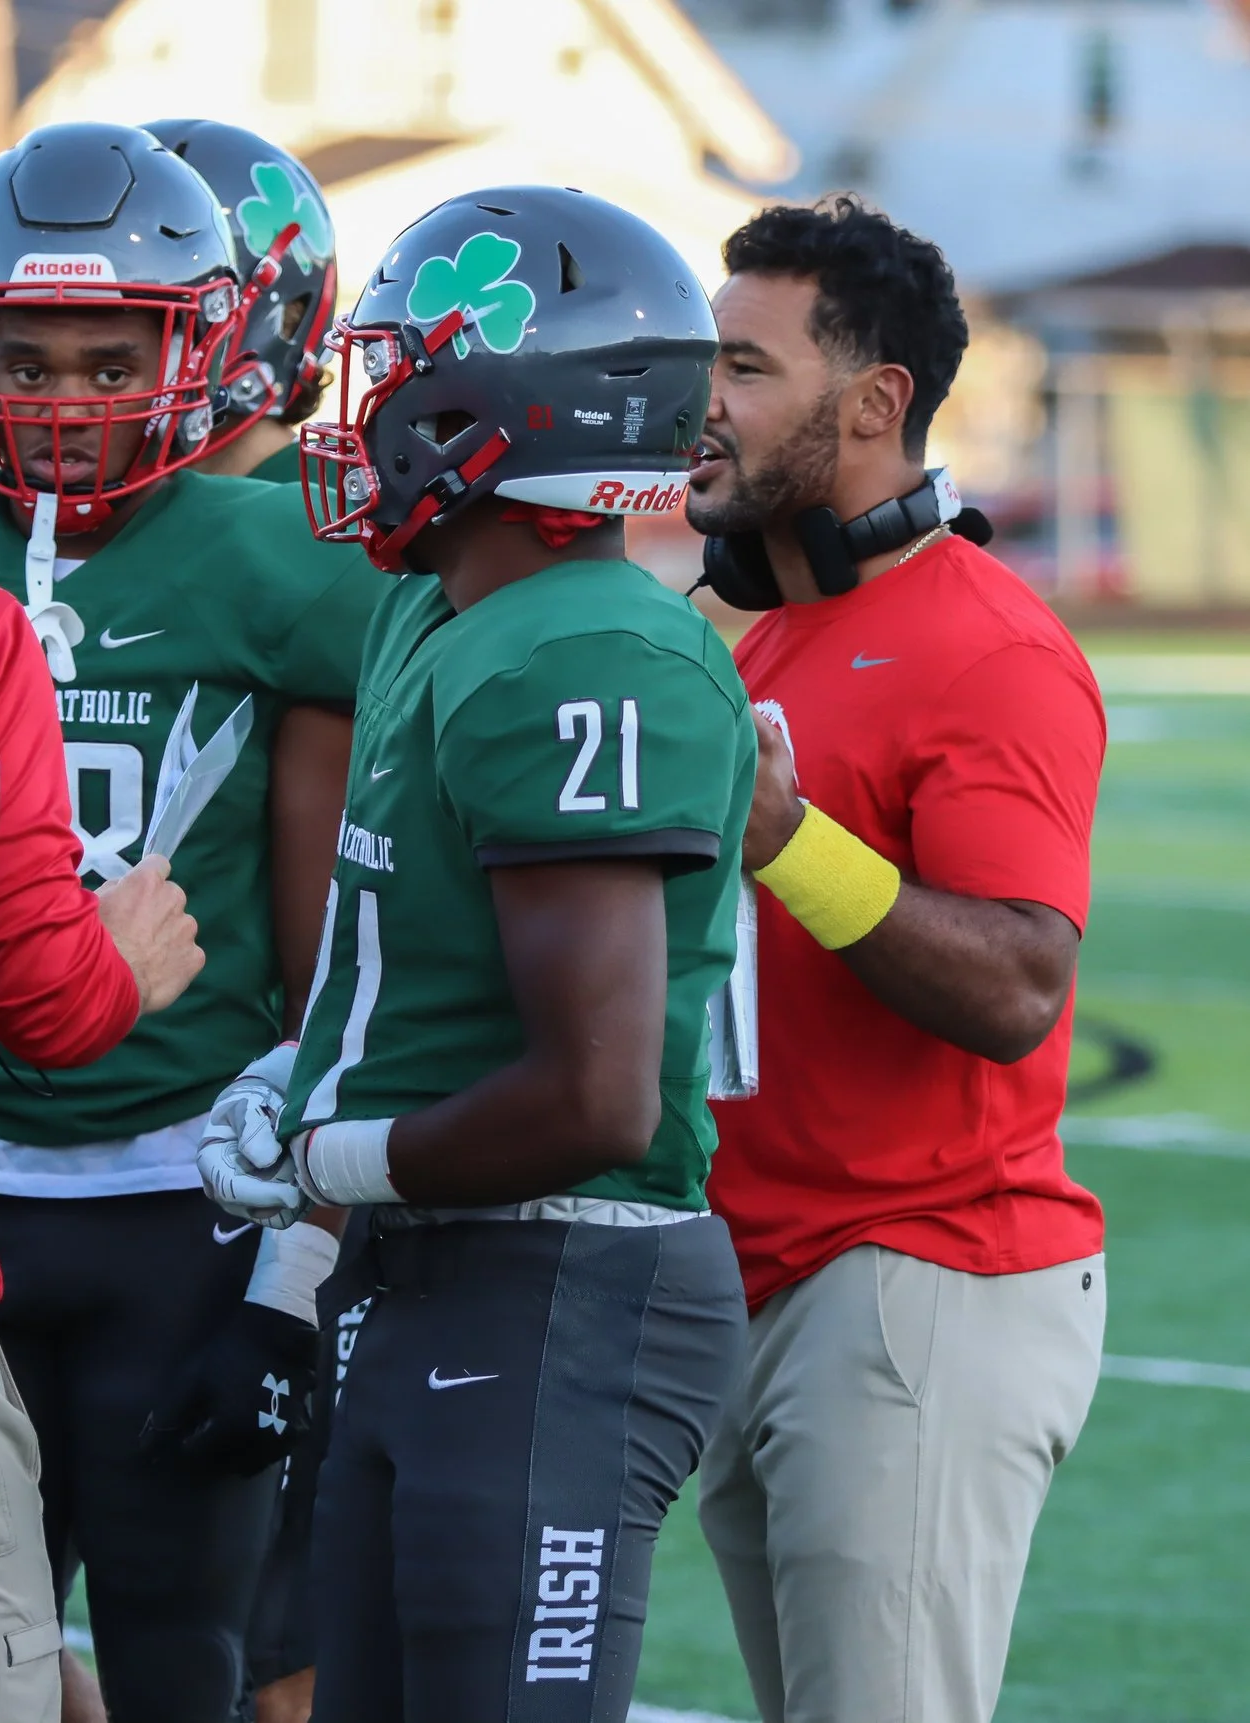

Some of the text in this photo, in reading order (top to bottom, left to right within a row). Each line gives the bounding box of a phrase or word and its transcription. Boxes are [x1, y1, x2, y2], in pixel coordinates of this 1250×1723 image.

[23, 261, 102, 276] Riddell
[527, 404, 554, 430] 21
[574, 409, 613, 421] Riddell
[555, 696, 640, 812] 21
[344, 824, 394, 873] CATHOLIC
[526, 1525, 606, 1683] IRISH
